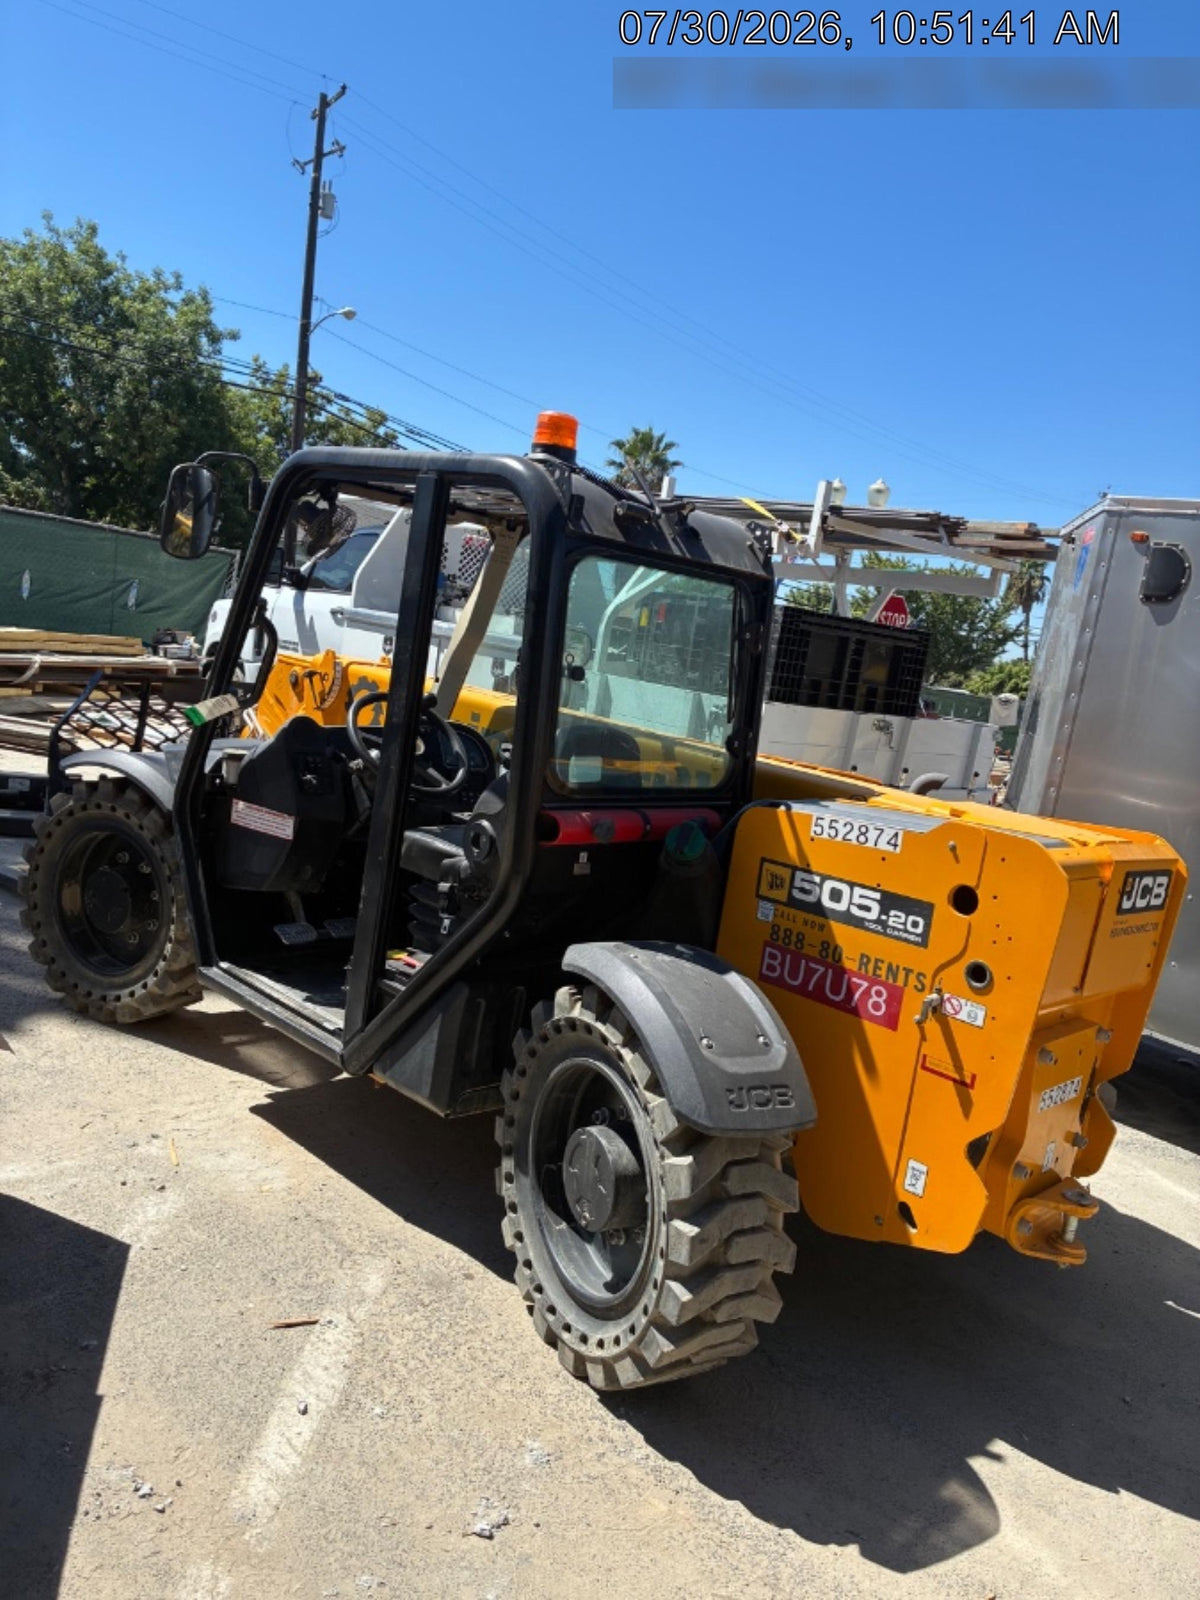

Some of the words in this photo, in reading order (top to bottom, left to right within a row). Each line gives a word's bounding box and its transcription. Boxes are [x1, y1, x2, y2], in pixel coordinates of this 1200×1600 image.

[813, 816, 899, 850] 552874
[1121, 876, 1169, 910] JCB
[773, 908, 798, 924] CALL
[802, 917, 826, 932] NOW
[769, 923, 927, 993] 888-80-RENTS
[762, 946, 888, 1017] BU7U78
[725, 1085, 795, 1112] JCB
